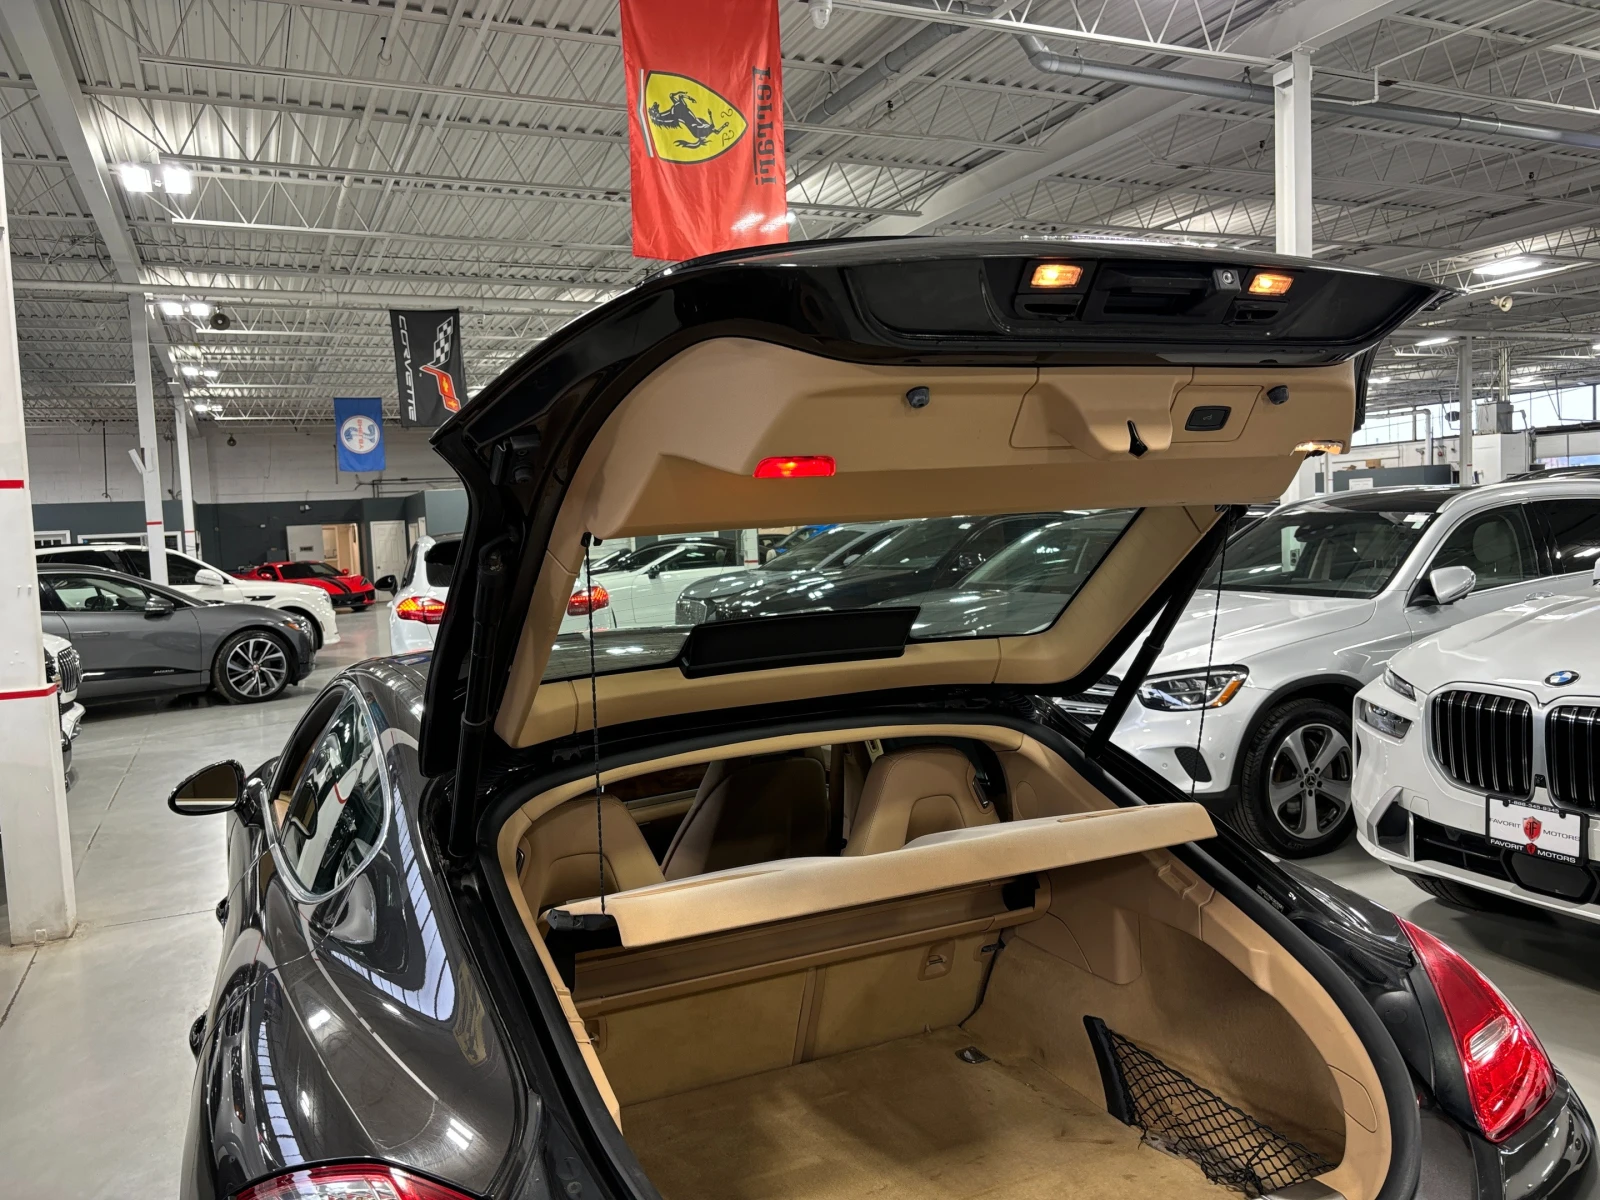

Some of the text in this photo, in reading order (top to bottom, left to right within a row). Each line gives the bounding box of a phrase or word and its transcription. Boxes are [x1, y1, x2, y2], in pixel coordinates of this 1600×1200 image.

[752, 65, 776, 185] Ferrari
[399, 315, 417, 421] CORVETTE
[1490, 817, 1580, 841] FAVORIT MOTORS
[1490, 838, 1576, 864] FAVORIT MOTORS
